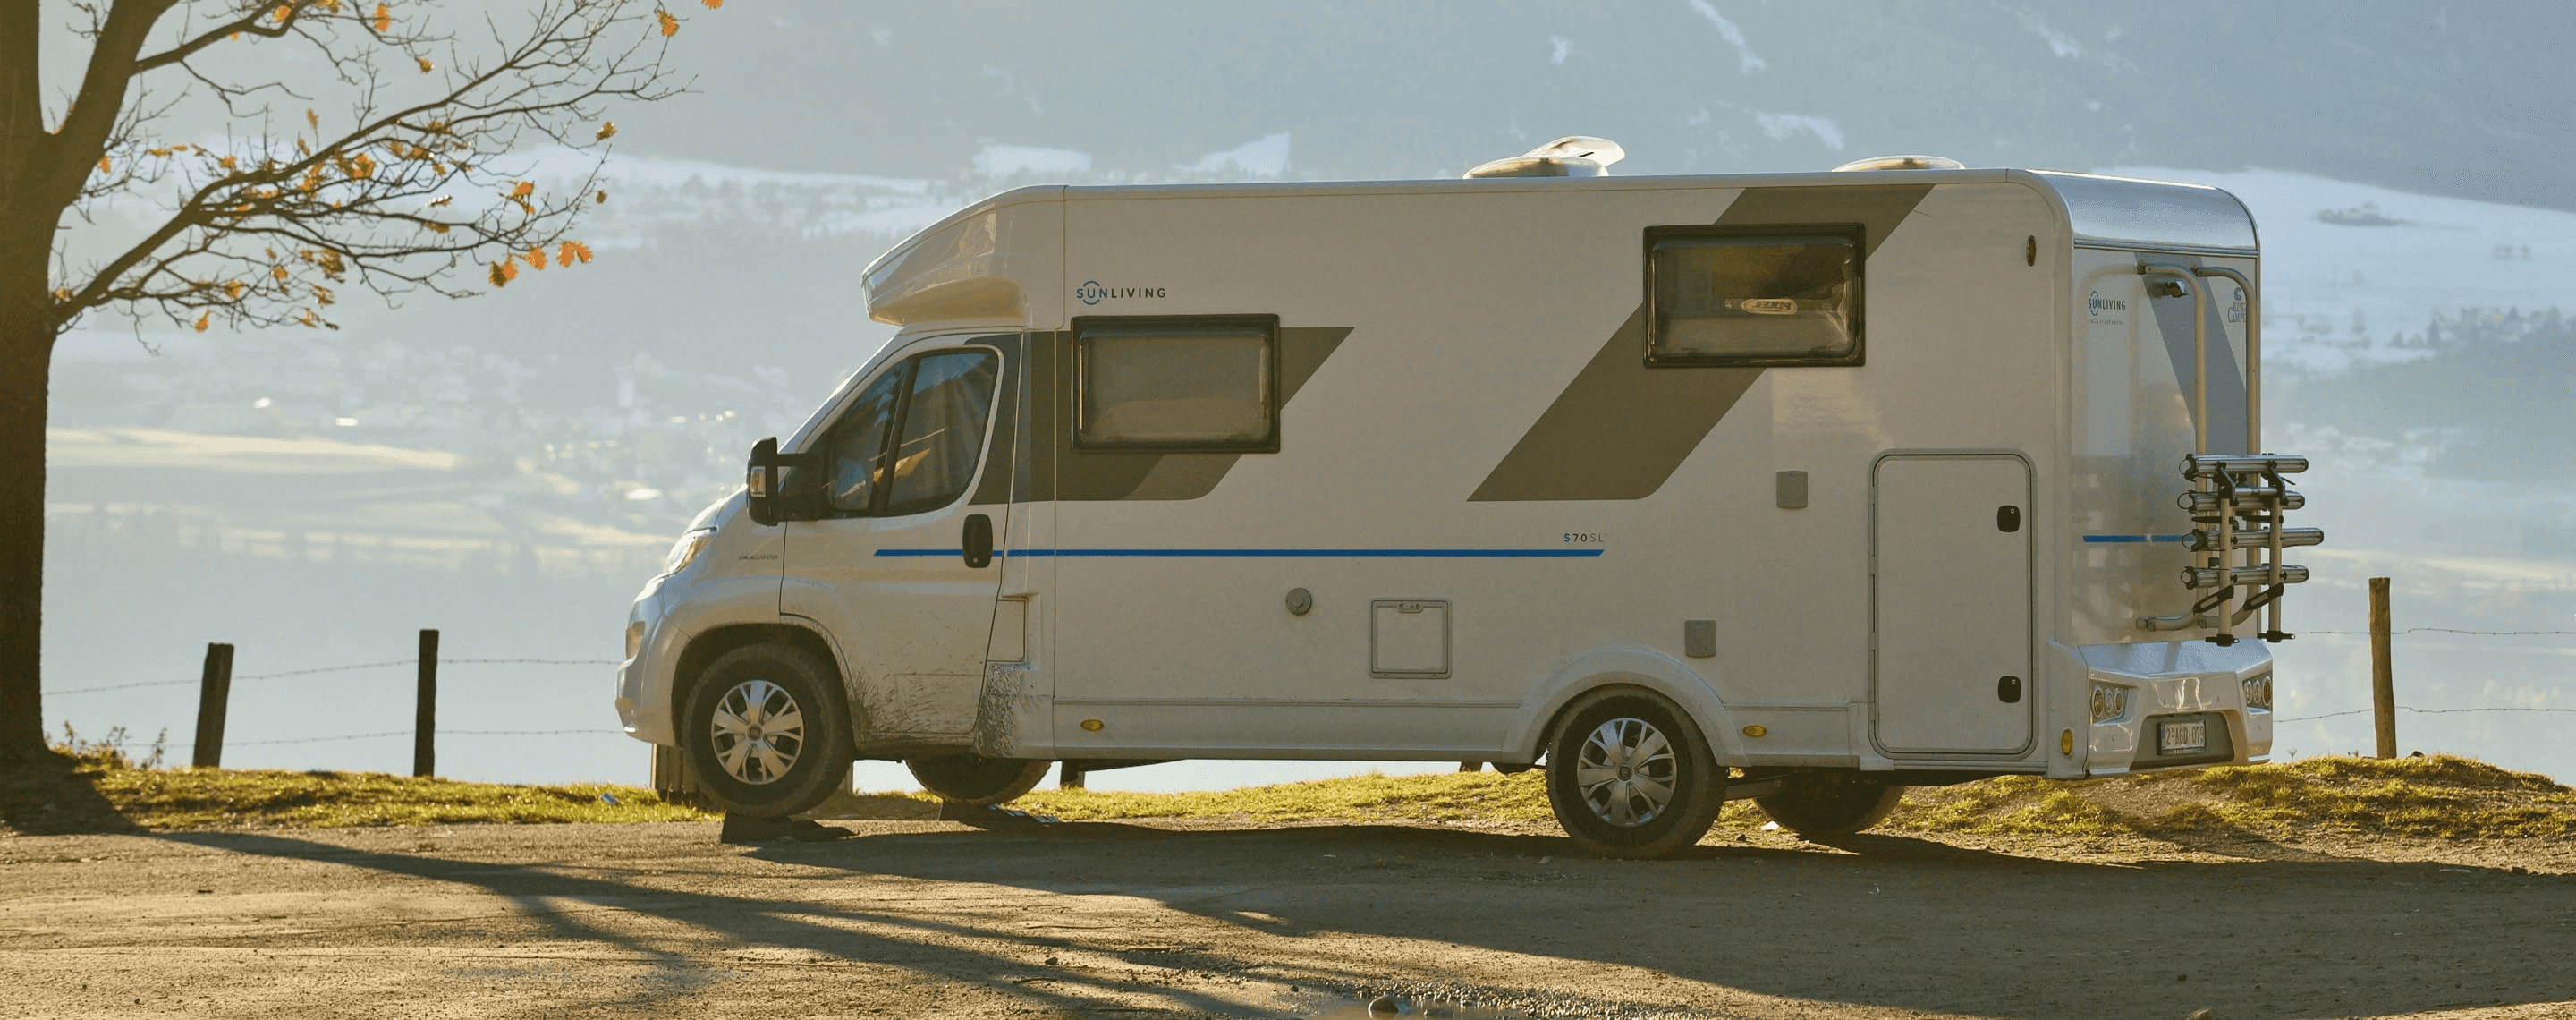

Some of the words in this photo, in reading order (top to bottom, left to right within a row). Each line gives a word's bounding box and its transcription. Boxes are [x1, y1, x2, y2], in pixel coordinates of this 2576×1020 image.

[1076, 286, 1166, 300] SUNLIVING
[2088, 297, 2126, 311] SUNLIVING
[2233, 302, 2246, 312] KIN
